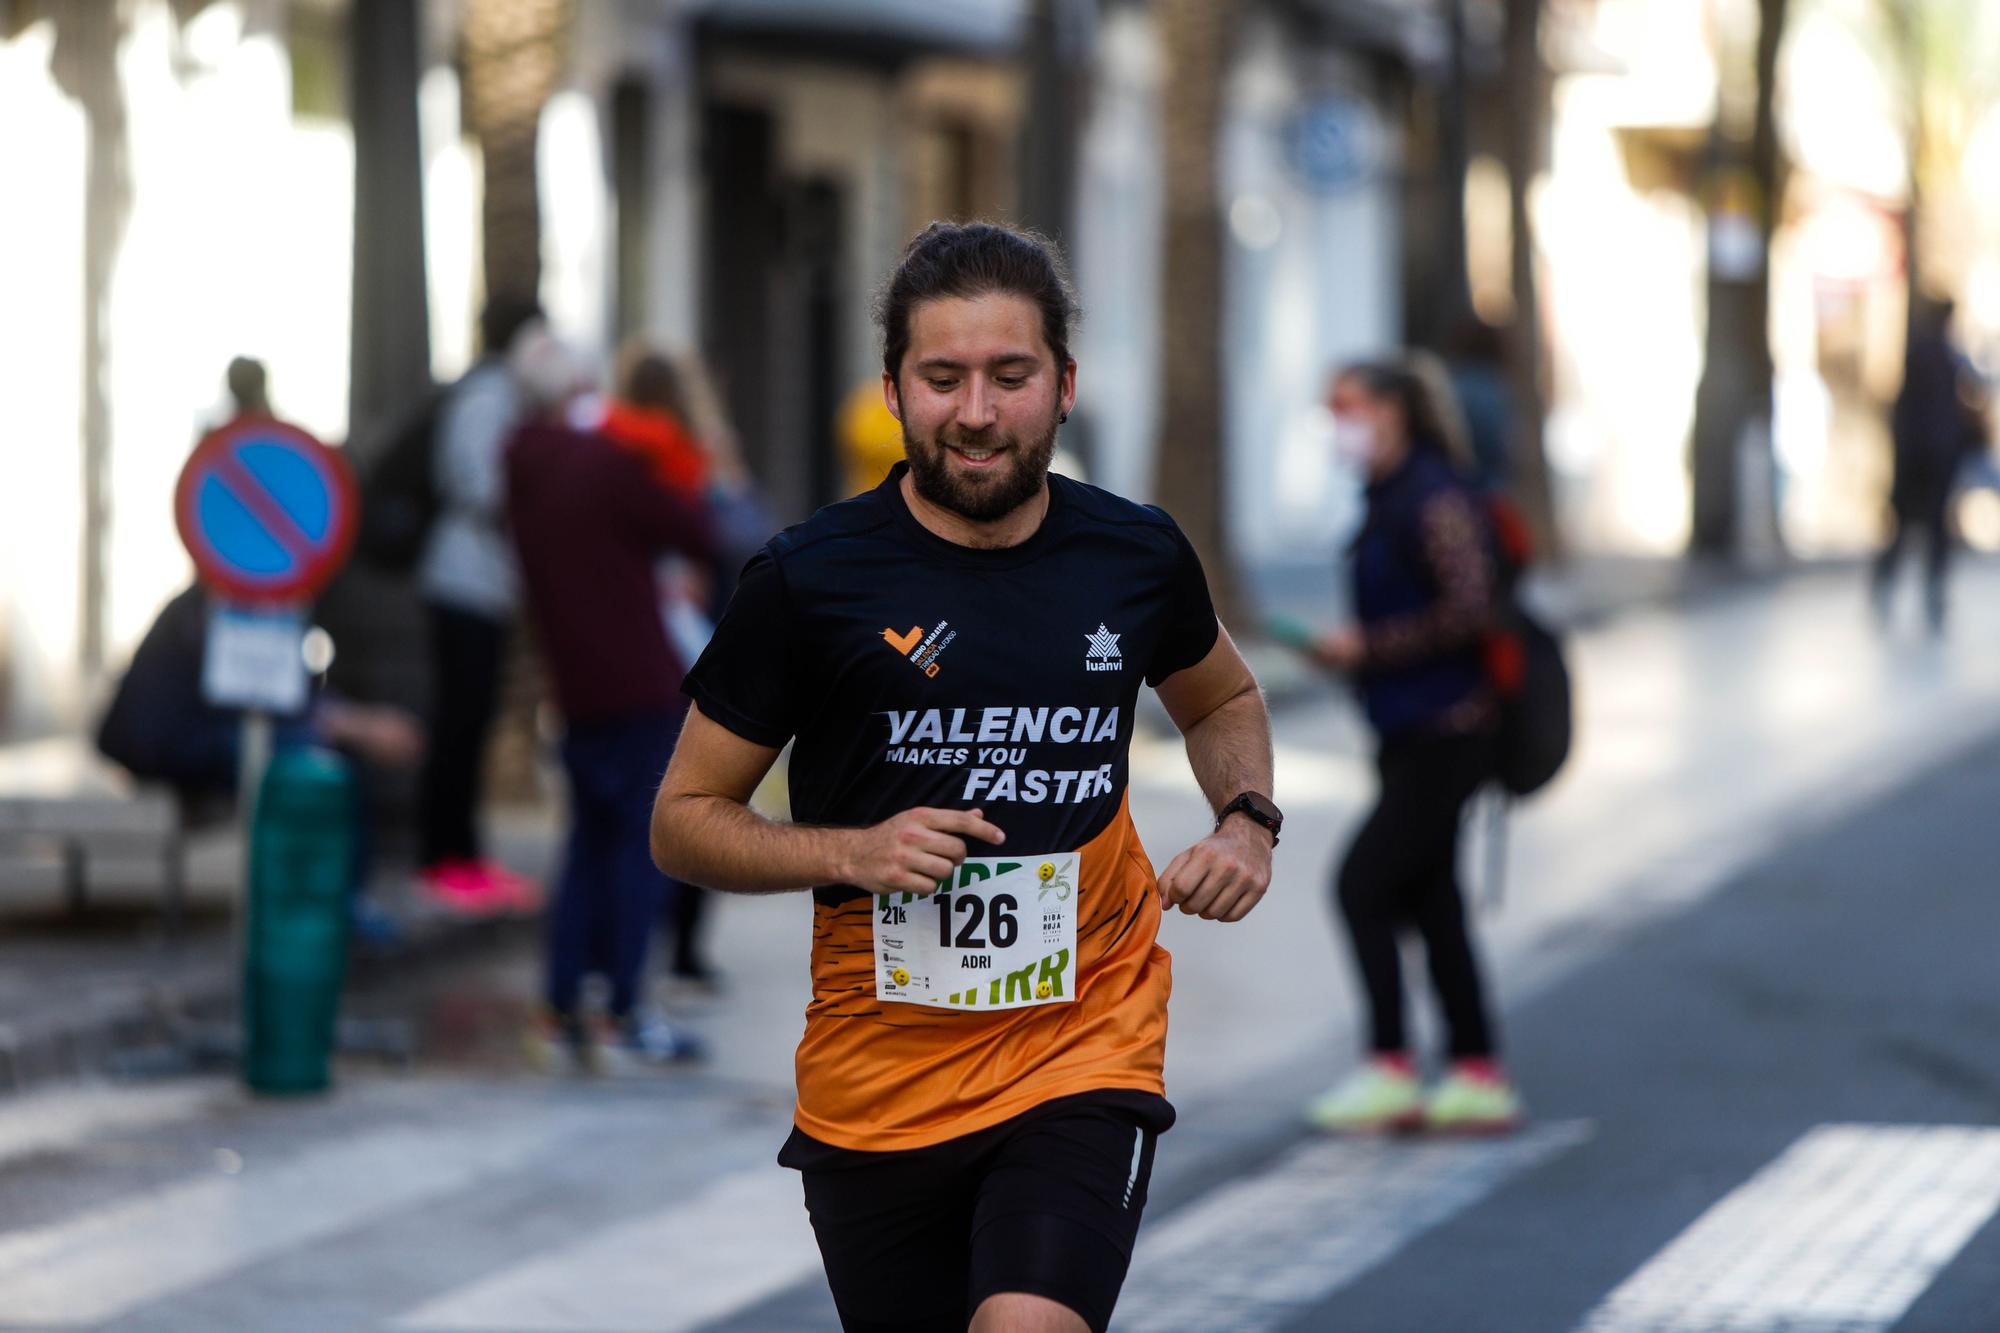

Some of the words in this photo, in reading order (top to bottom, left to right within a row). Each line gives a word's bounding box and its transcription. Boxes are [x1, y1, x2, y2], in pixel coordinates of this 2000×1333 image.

[910, 645, 926, 663] MEDIO
[924, 620, 949, 646] MARATÓN
[939, 630, 957, 652] ALFONSO
[1085, 659, 1123, 672] luanvi
[887, 706, 1120, 744] VALENCIA
[885, 747, 970, 766] MAKES
[977, 747, 1028, 765] YOU
[880, 905, 907, 925] 21k
[933, 893, 1019, 949] 126
[960, 955, 991, 969] ADRI
